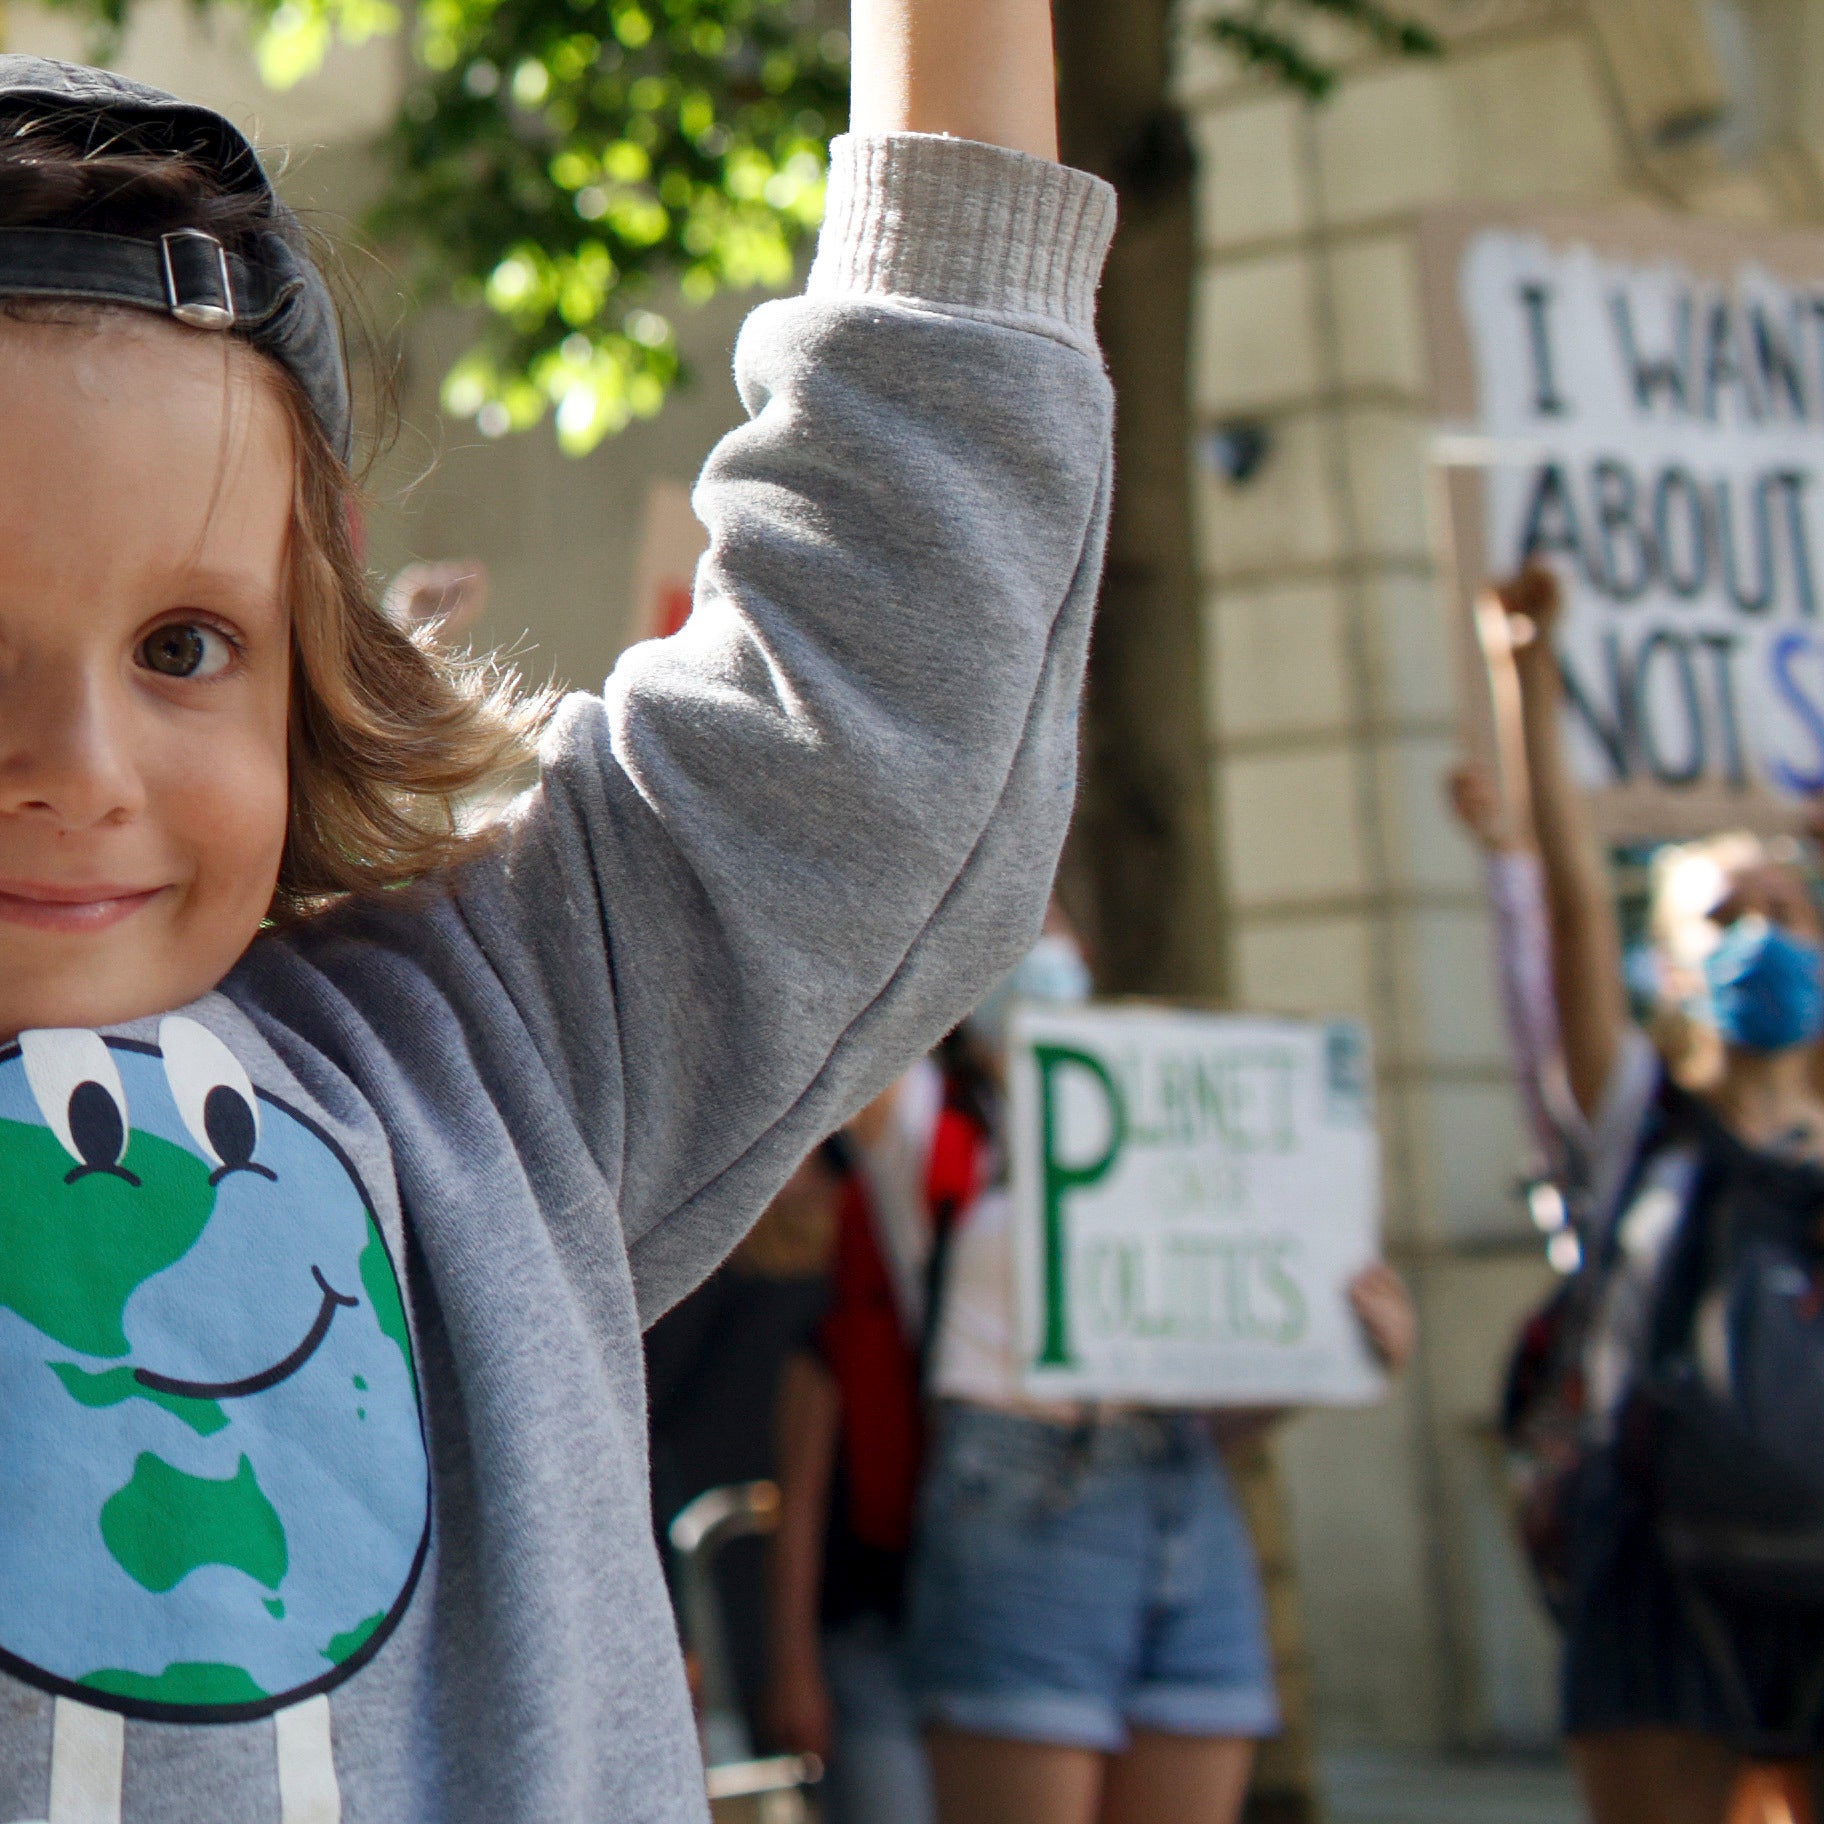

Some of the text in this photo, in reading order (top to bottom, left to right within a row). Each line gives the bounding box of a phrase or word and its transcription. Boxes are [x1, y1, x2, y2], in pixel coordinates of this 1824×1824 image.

[1514, 280, 1824, 426] I WAN
[1520, 461, 1818, 616] ABOUT
